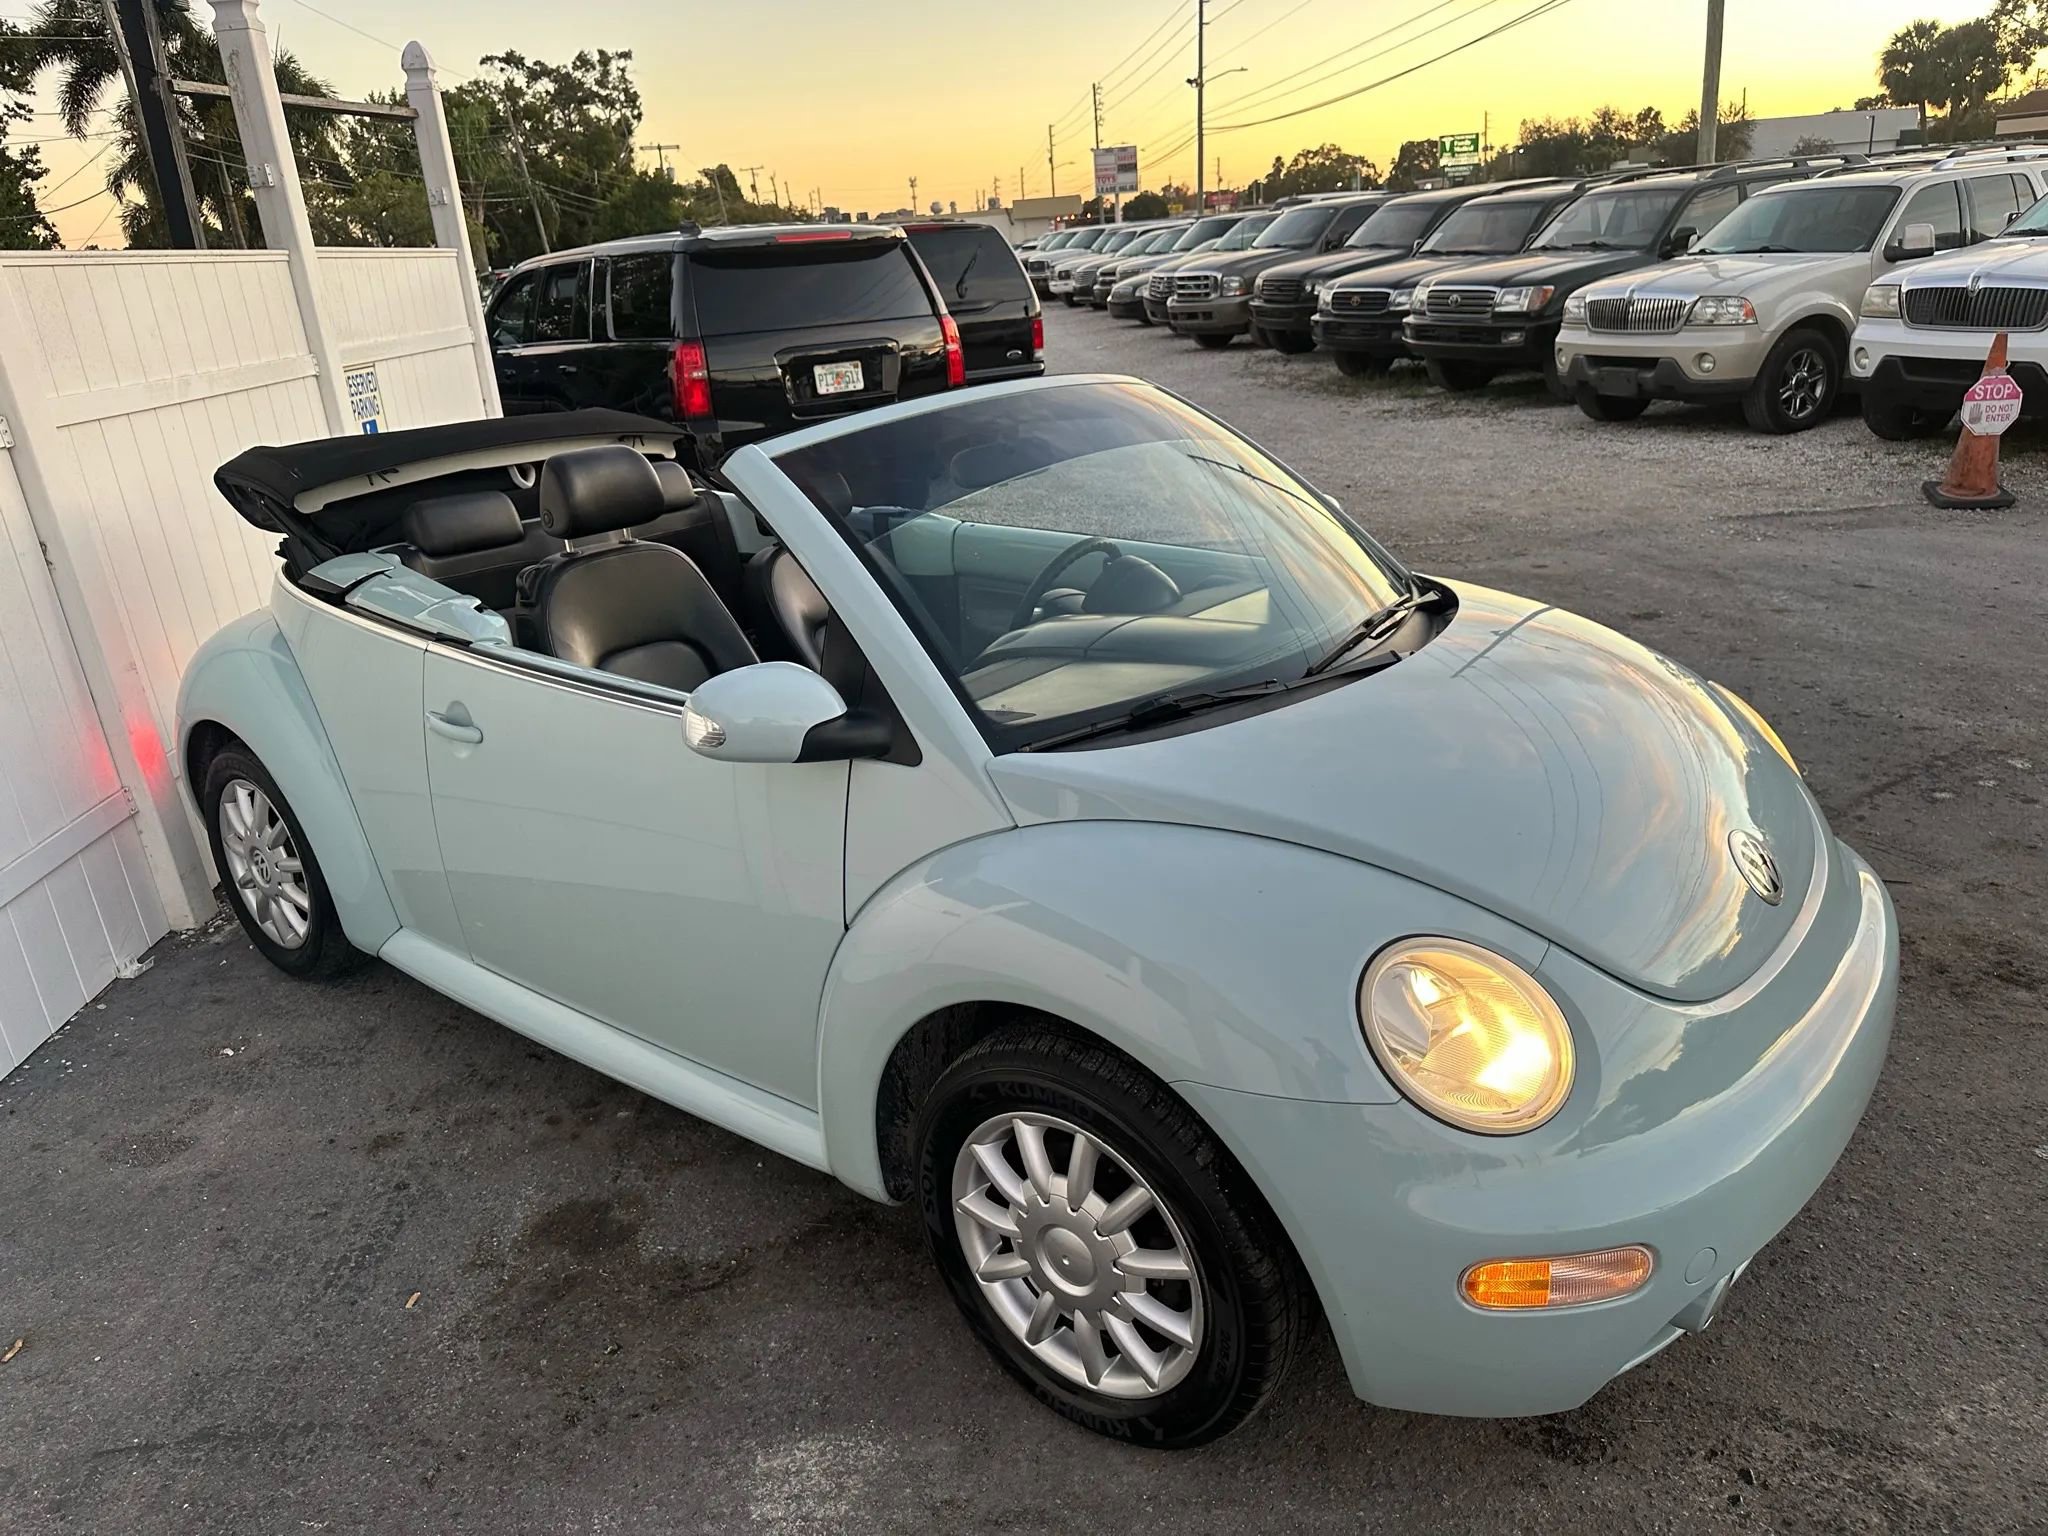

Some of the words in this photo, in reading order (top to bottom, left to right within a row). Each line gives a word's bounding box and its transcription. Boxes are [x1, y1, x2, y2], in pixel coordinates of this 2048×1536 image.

[1974, 383, 2014, 400] STOP
[350, 394, 380, 422] PARKING
[1985, 404, 1997, 413] DO
[1999, 403, 2014, 413] NOT
[1985, 413, 2011, 423] ENTER
